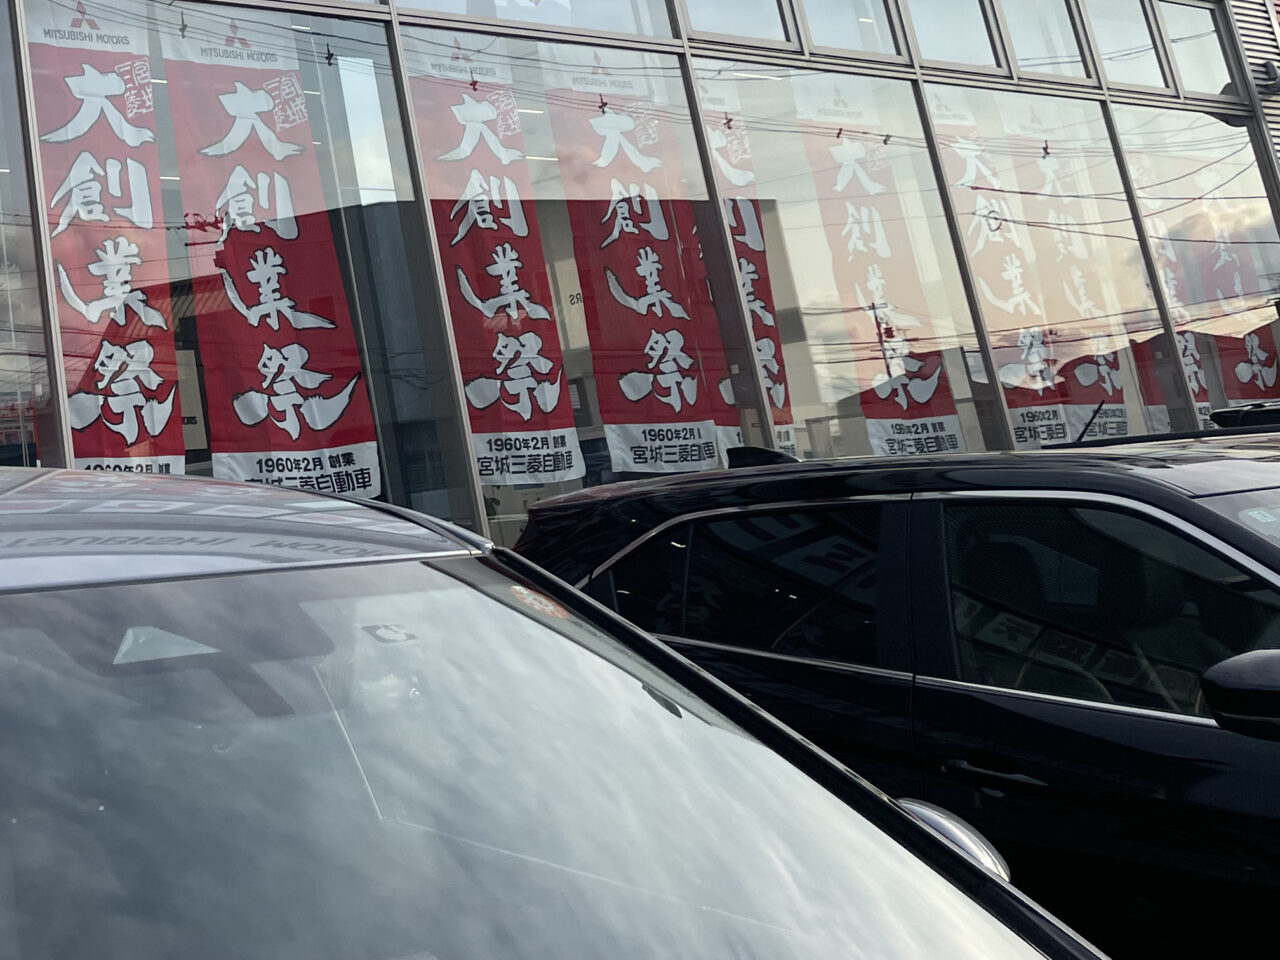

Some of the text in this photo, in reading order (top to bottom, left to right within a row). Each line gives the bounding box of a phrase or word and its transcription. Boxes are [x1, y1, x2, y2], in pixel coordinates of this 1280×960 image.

[43, 28, 130, 45] MITSUBISHI MOTORS
[200, 47, 278, 62] MITSUBISHI MOTORS
[39, 62, 178, 447] 大創業祭
[197, 80, 362, 440] 大創業祭
[435, 92, 564, 422] 大創業祭
[589, 106, 697, 414] 大創業祭
[486, 436, 549, 452] 1960年2月
[256, 452, 356, 473] 1960年2月 創業
[477, 450, 574, 477] 宮城三菱自動車
